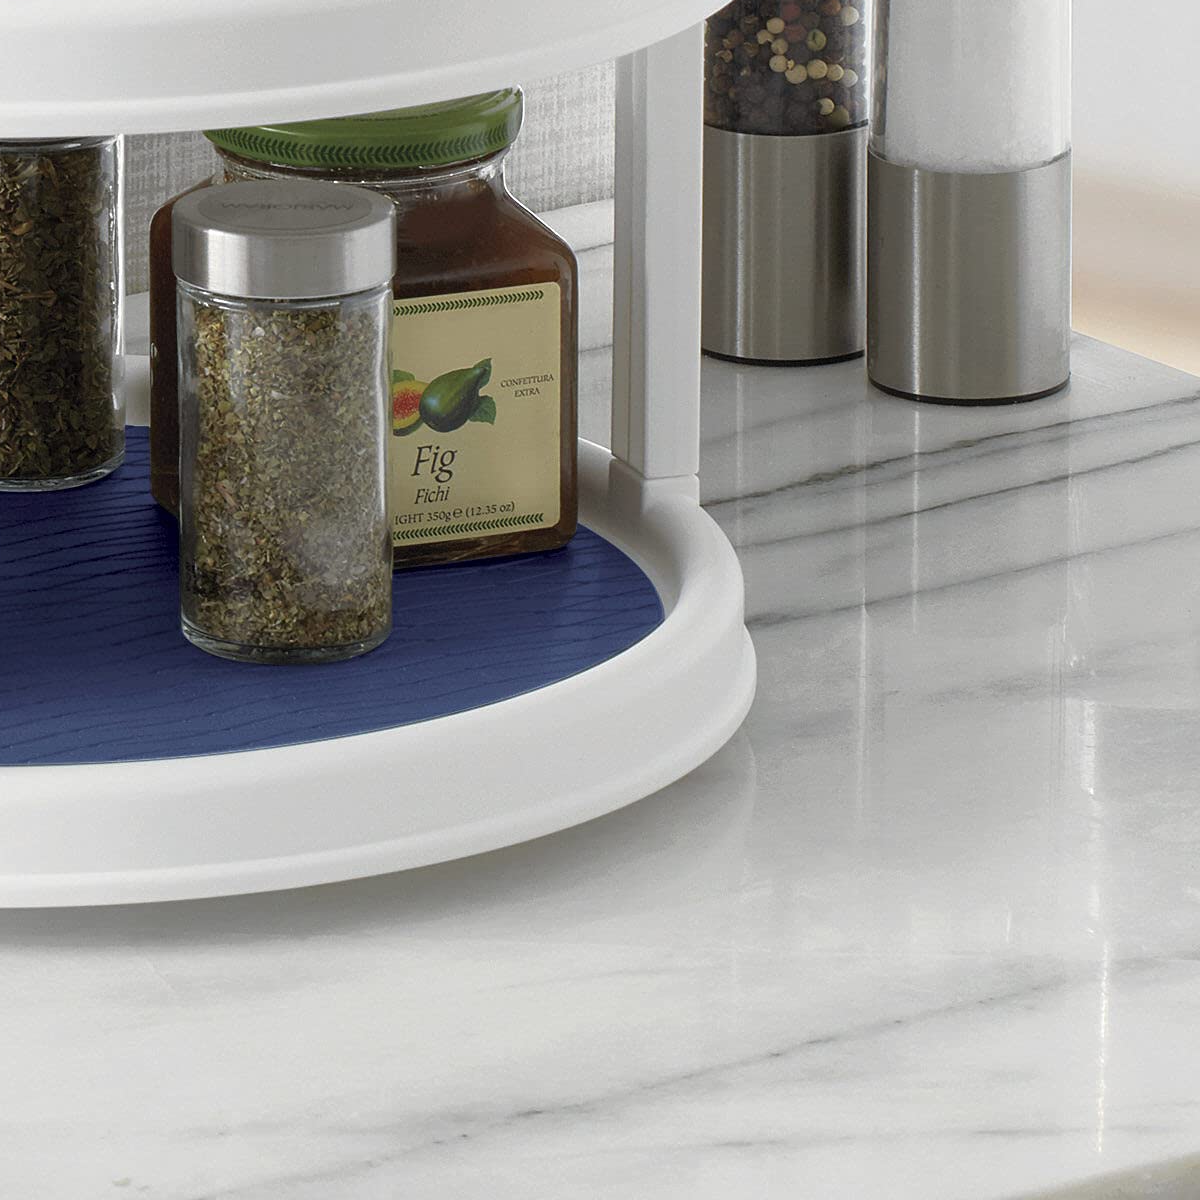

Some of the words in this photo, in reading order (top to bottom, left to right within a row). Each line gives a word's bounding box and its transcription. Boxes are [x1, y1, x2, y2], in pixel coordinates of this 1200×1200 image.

[501, 373, 554, 389] CONFETTURA
[514, 387, 541, 399] EXTRA
[410, 444, 458, 484] Fig
[414, 485, 451, 505] Fichi
[465, 503, 497, 518] (12.35
[499, 501, 515, 513] oz)
